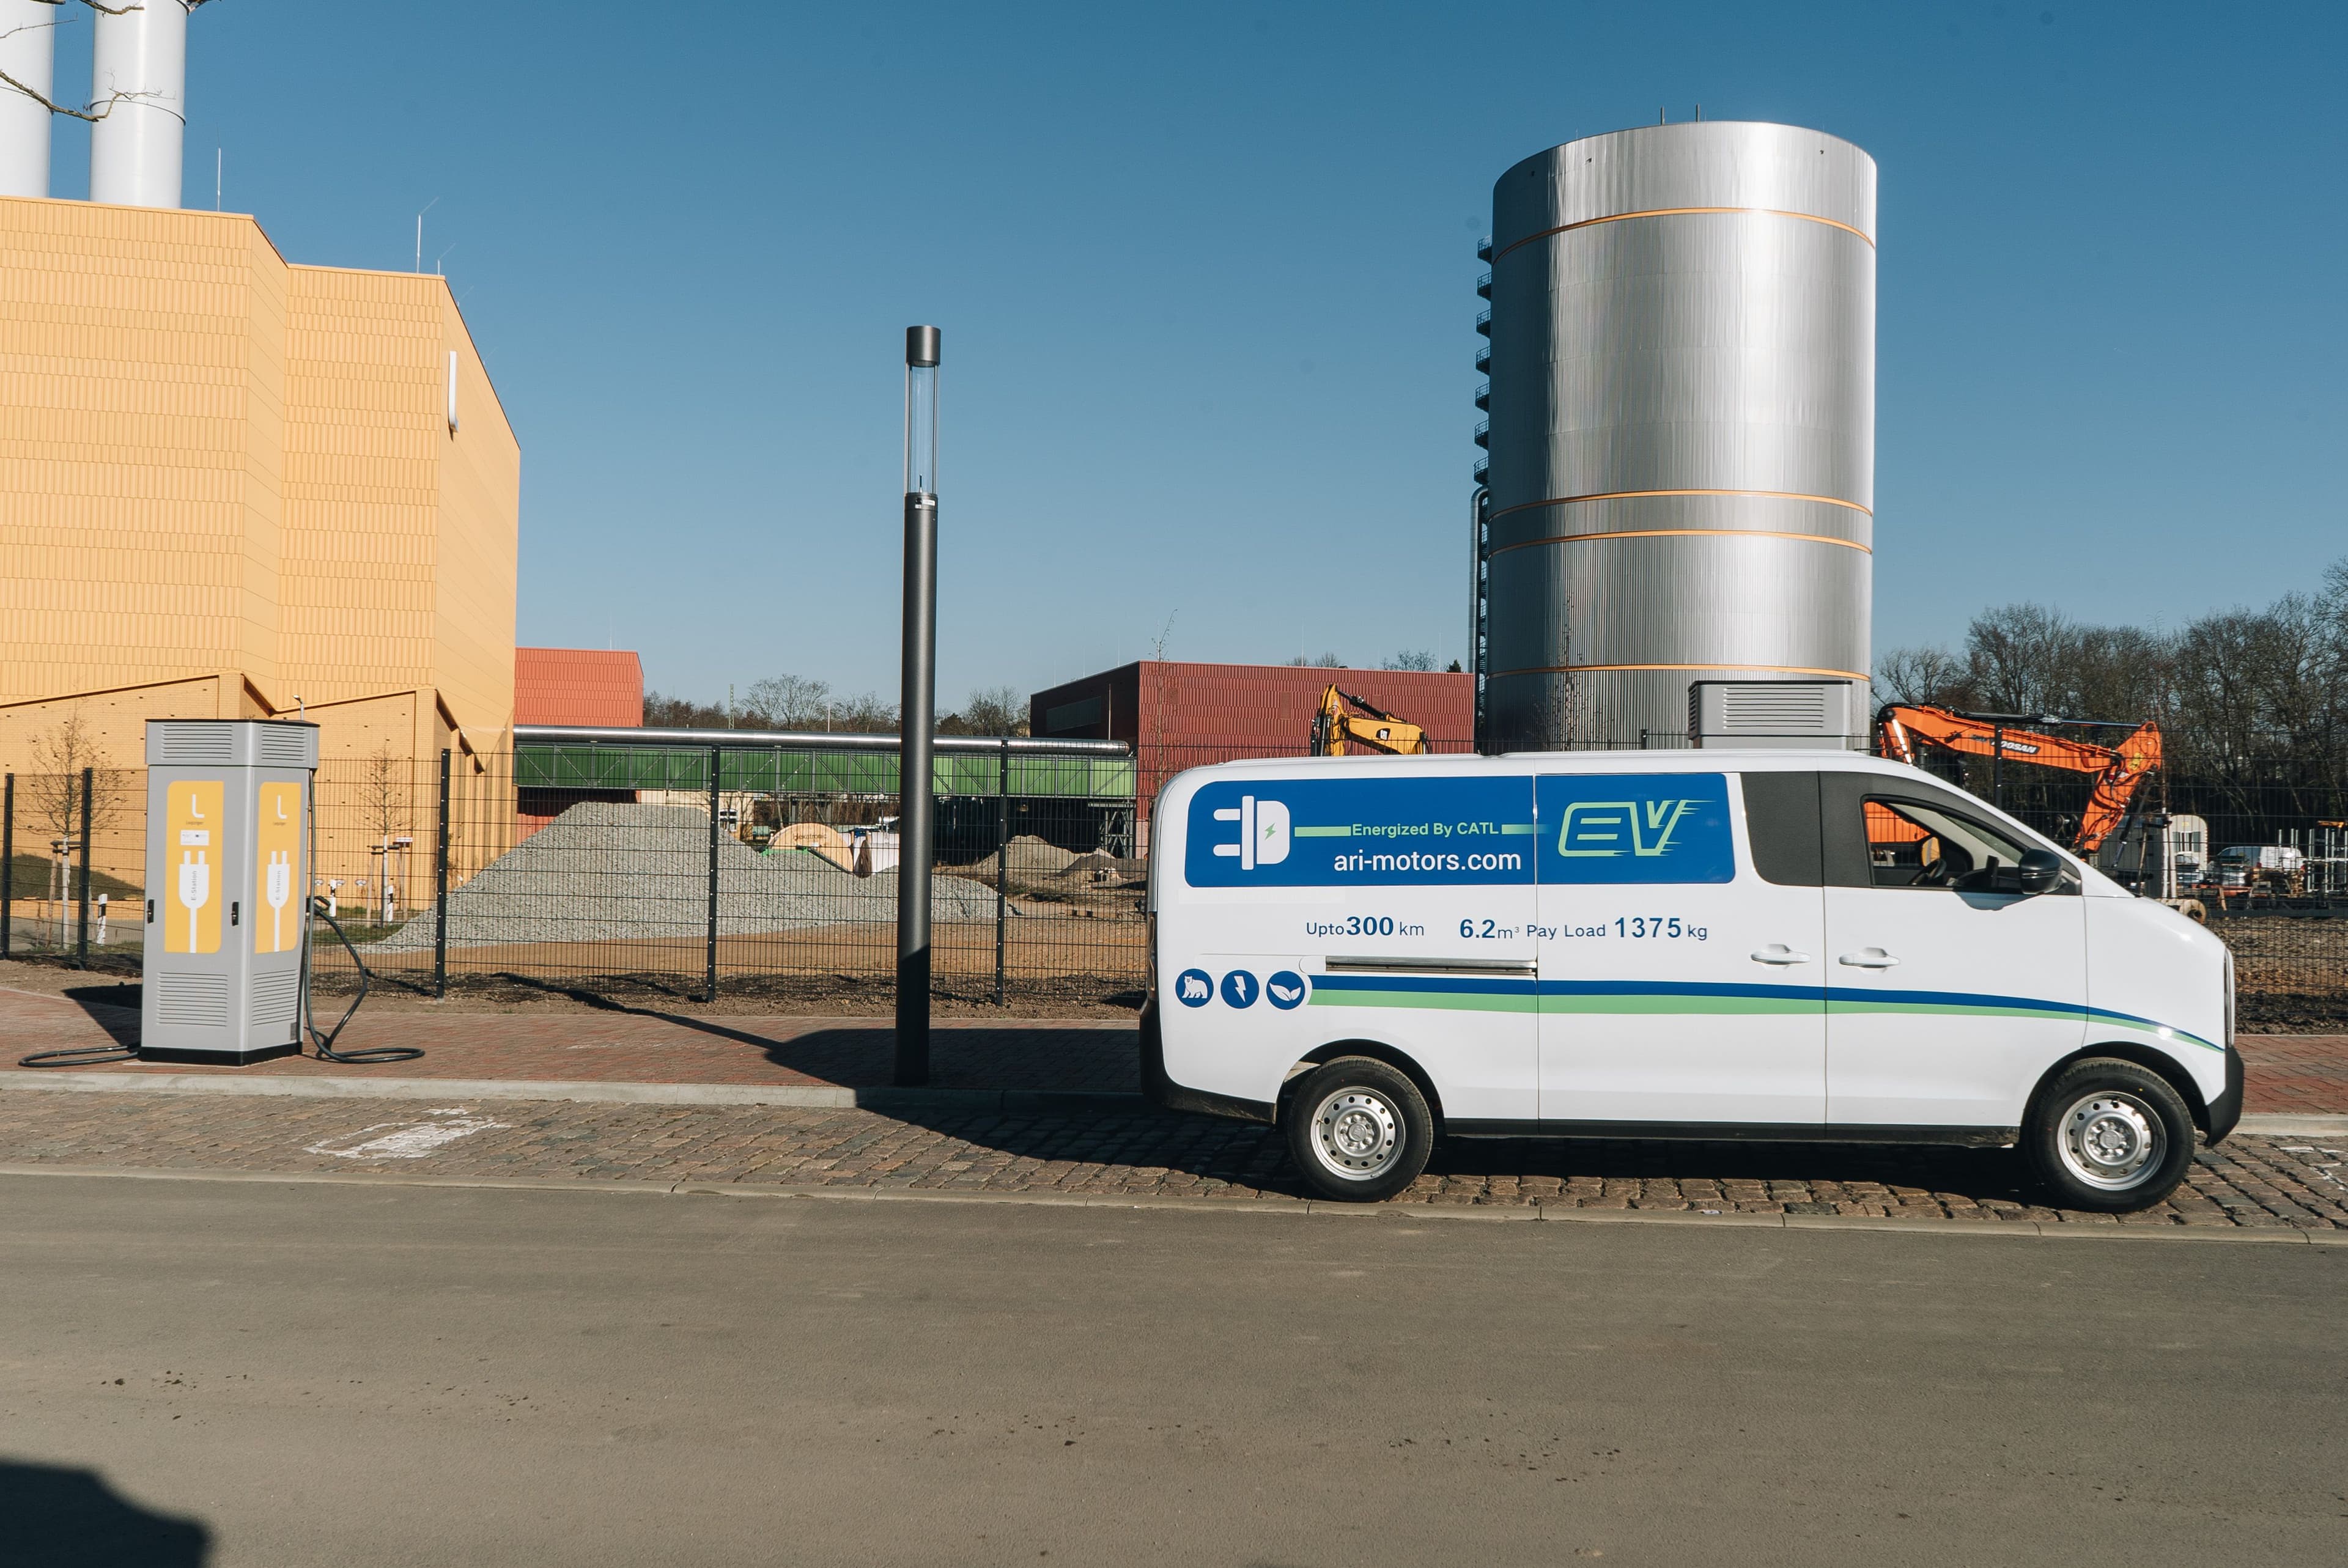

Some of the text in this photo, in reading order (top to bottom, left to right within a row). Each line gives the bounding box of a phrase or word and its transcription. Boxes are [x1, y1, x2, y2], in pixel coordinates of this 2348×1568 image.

[1352, 822, 1499, 839] Energized By CATL
[1557, 799, 1715, 857] EV
[1334, 849, 1521, 871] ari-motors.com
[1399, 921, 1424, 936] km
[1527, 924, 1557, 941] Pay
[1564, 924, 1606, 937] Load
[1614, 916, 1682, 938] 1375
[1687, 924, 1707, 941] kg
